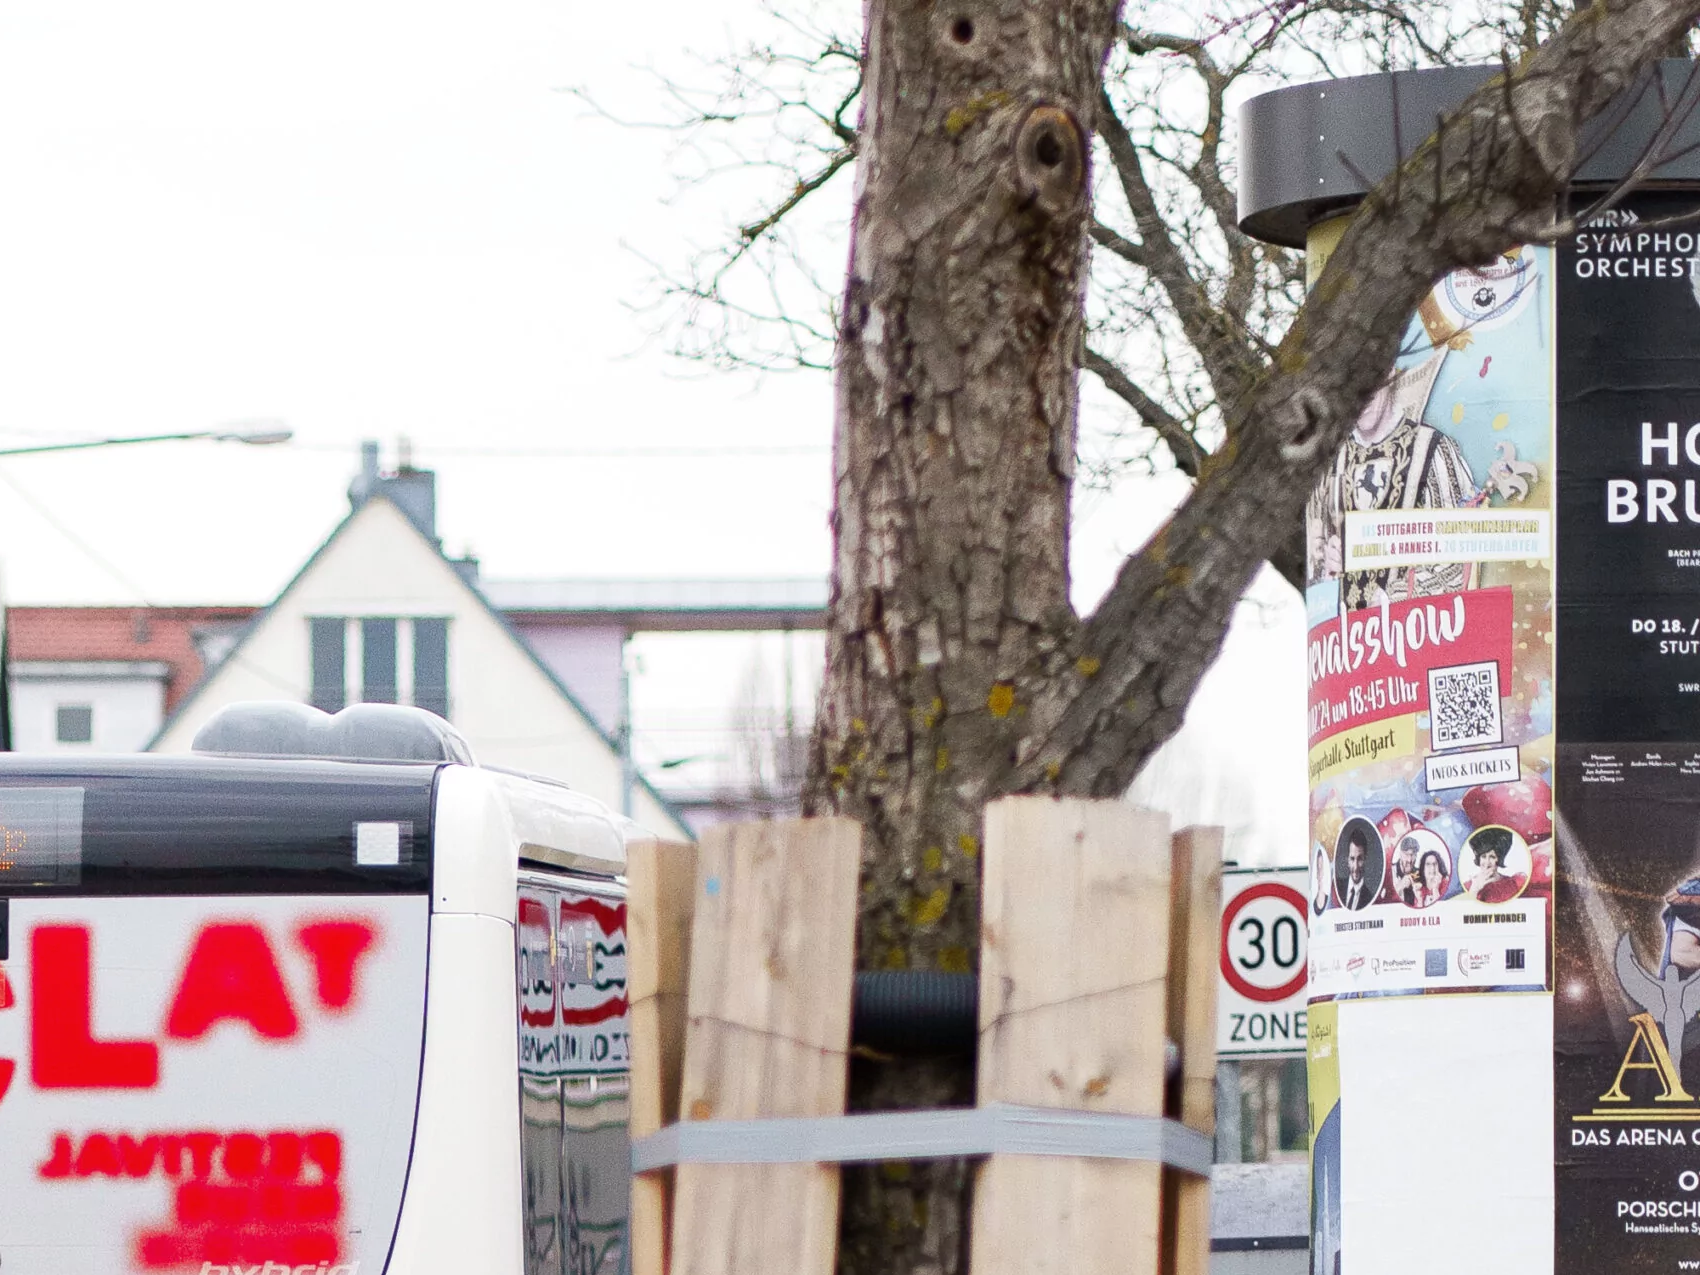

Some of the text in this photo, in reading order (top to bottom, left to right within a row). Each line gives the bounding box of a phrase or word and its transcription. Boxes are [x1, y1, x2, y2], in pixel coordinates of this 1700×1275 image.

[1576, 232, 1700, 253] SYMPHO
[1576, 257, 1700, 278] ORCHEST
[1377, 522, 1433, 537] STUTTGARTER
[1399, 541, 1433, 555] HANNES
[1632, 619, 1657, 633] DO
[1661, 619, 1686, 633] 18.
[1349, 679, 1385, 717] 18:45
[1388, 676, 1420, 706] Uhr
[1344, 728, 1396, 760] Stuttgart
[1432, 758, 1512, 781] INFOS & TICKETS
[1494, 913, 1527, 923] WONDER
[1238, 915, 1299, 970] 30
[1229, 1011, 1308, 1043] ZONE
[1572, 1128, 1611, 1146] DAS
[1616, 1128, 1686, 1146] ARENA
[1678, 1170, 1700, 1191] O
[1617, 1201, 1700, 1218] PORSCH
[1625, 1222, 1689, 1233] Hanseatisches
